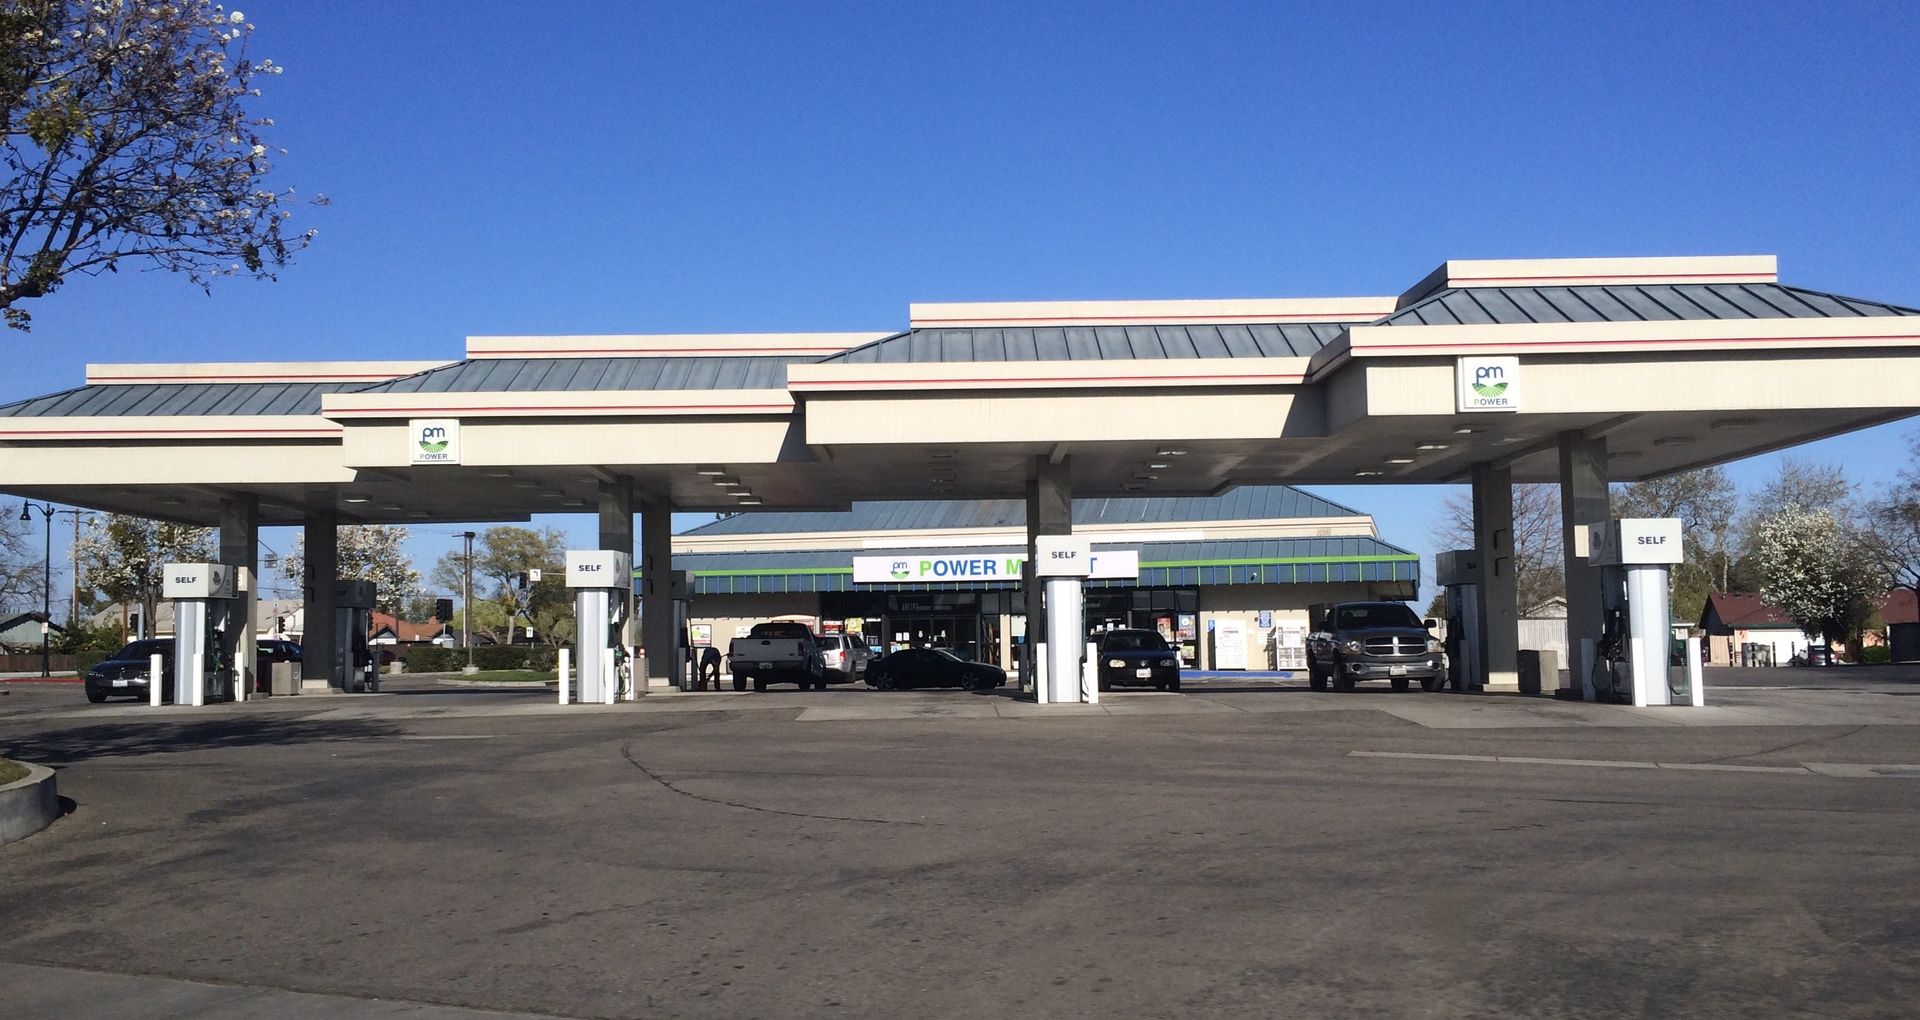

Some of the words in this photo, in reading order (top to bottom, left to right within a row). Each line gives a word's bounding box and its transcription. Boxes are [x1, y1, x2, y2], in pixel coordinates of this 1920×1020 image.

[1476, 366, 1503, 387] pm
[1474, 398, 1508, 406] POWER
[423, 427, 445, 443] pm
[1637, 536, 1666, 545] SELF
[1051, 551, 1077, 559] SELF
[578, 564, 602, 572] SELF
[892, 561, 908, 573] pm
[919, 559, 997, 577] POWER
[175, 576, 197, 584] SELF
